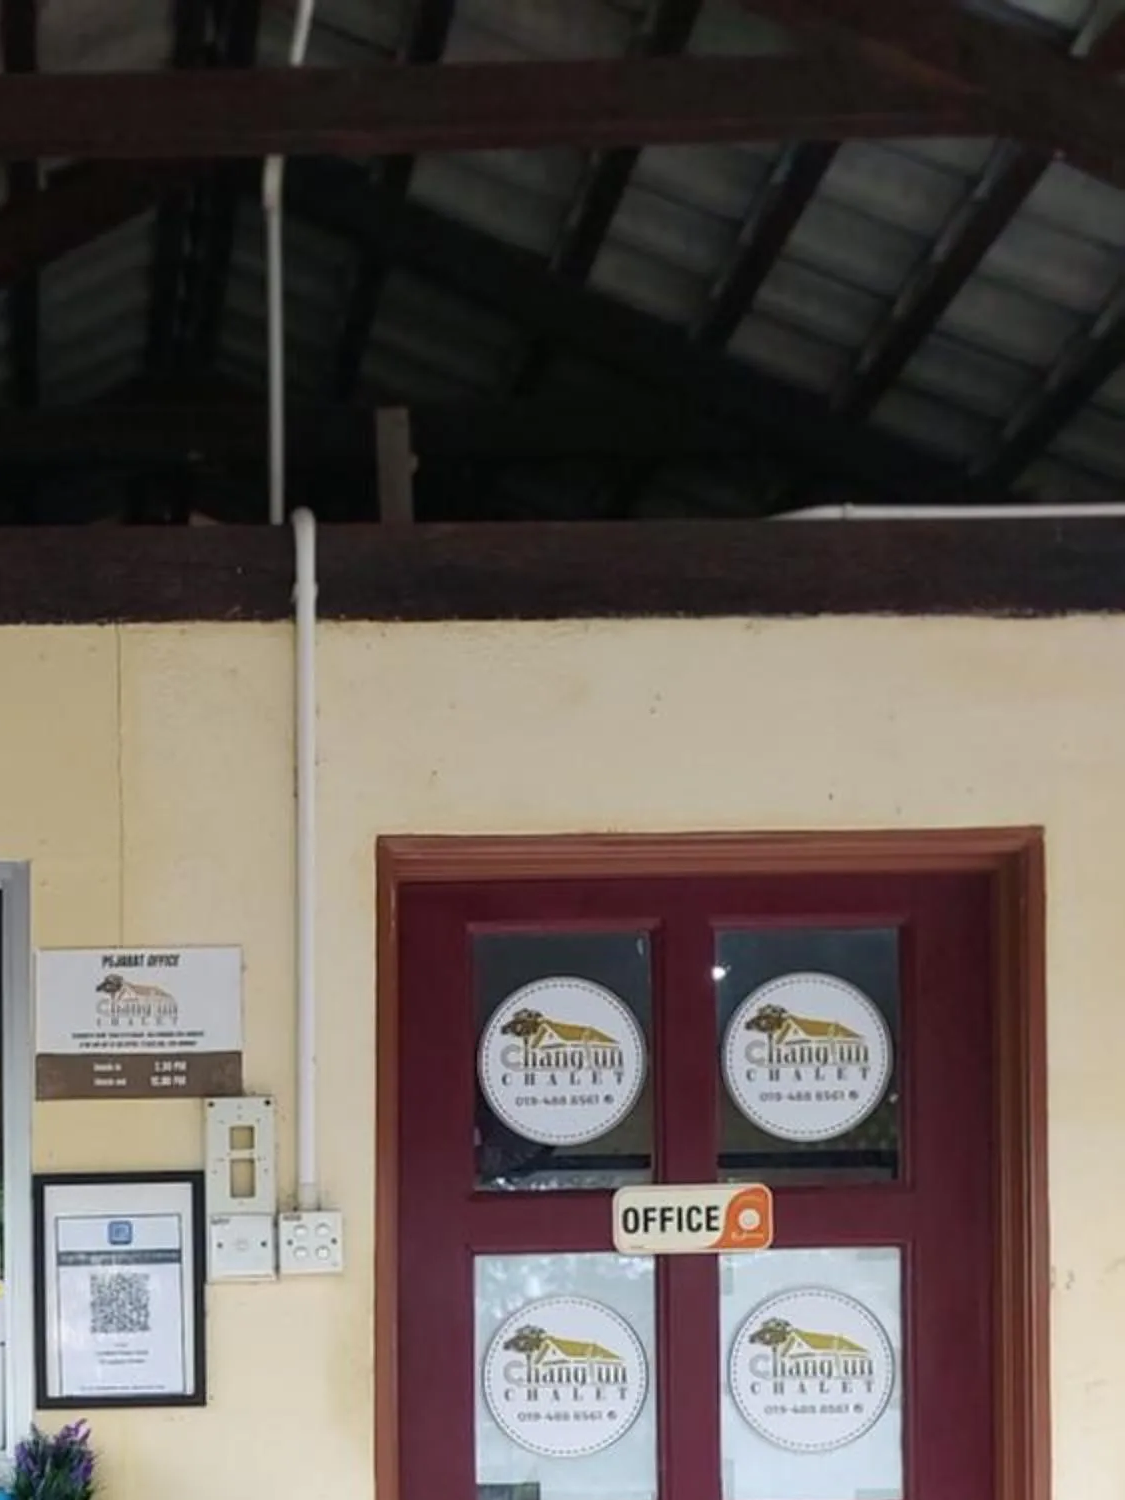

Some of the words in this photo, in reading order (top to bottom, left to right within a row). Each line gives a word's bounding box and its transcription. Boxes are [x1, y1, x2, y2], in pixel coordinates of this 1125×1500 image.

[147, 954, 180, 967] OFFICE
[501, 1071, 624, 1086] CHALET
[746, 1066, 870, 1082] CHALET
[621, 1205, 721, 1234] OFFICE
[504, 1386, 628, 1402] CHALET
[750, 1380, 872, 1396] CHALET
